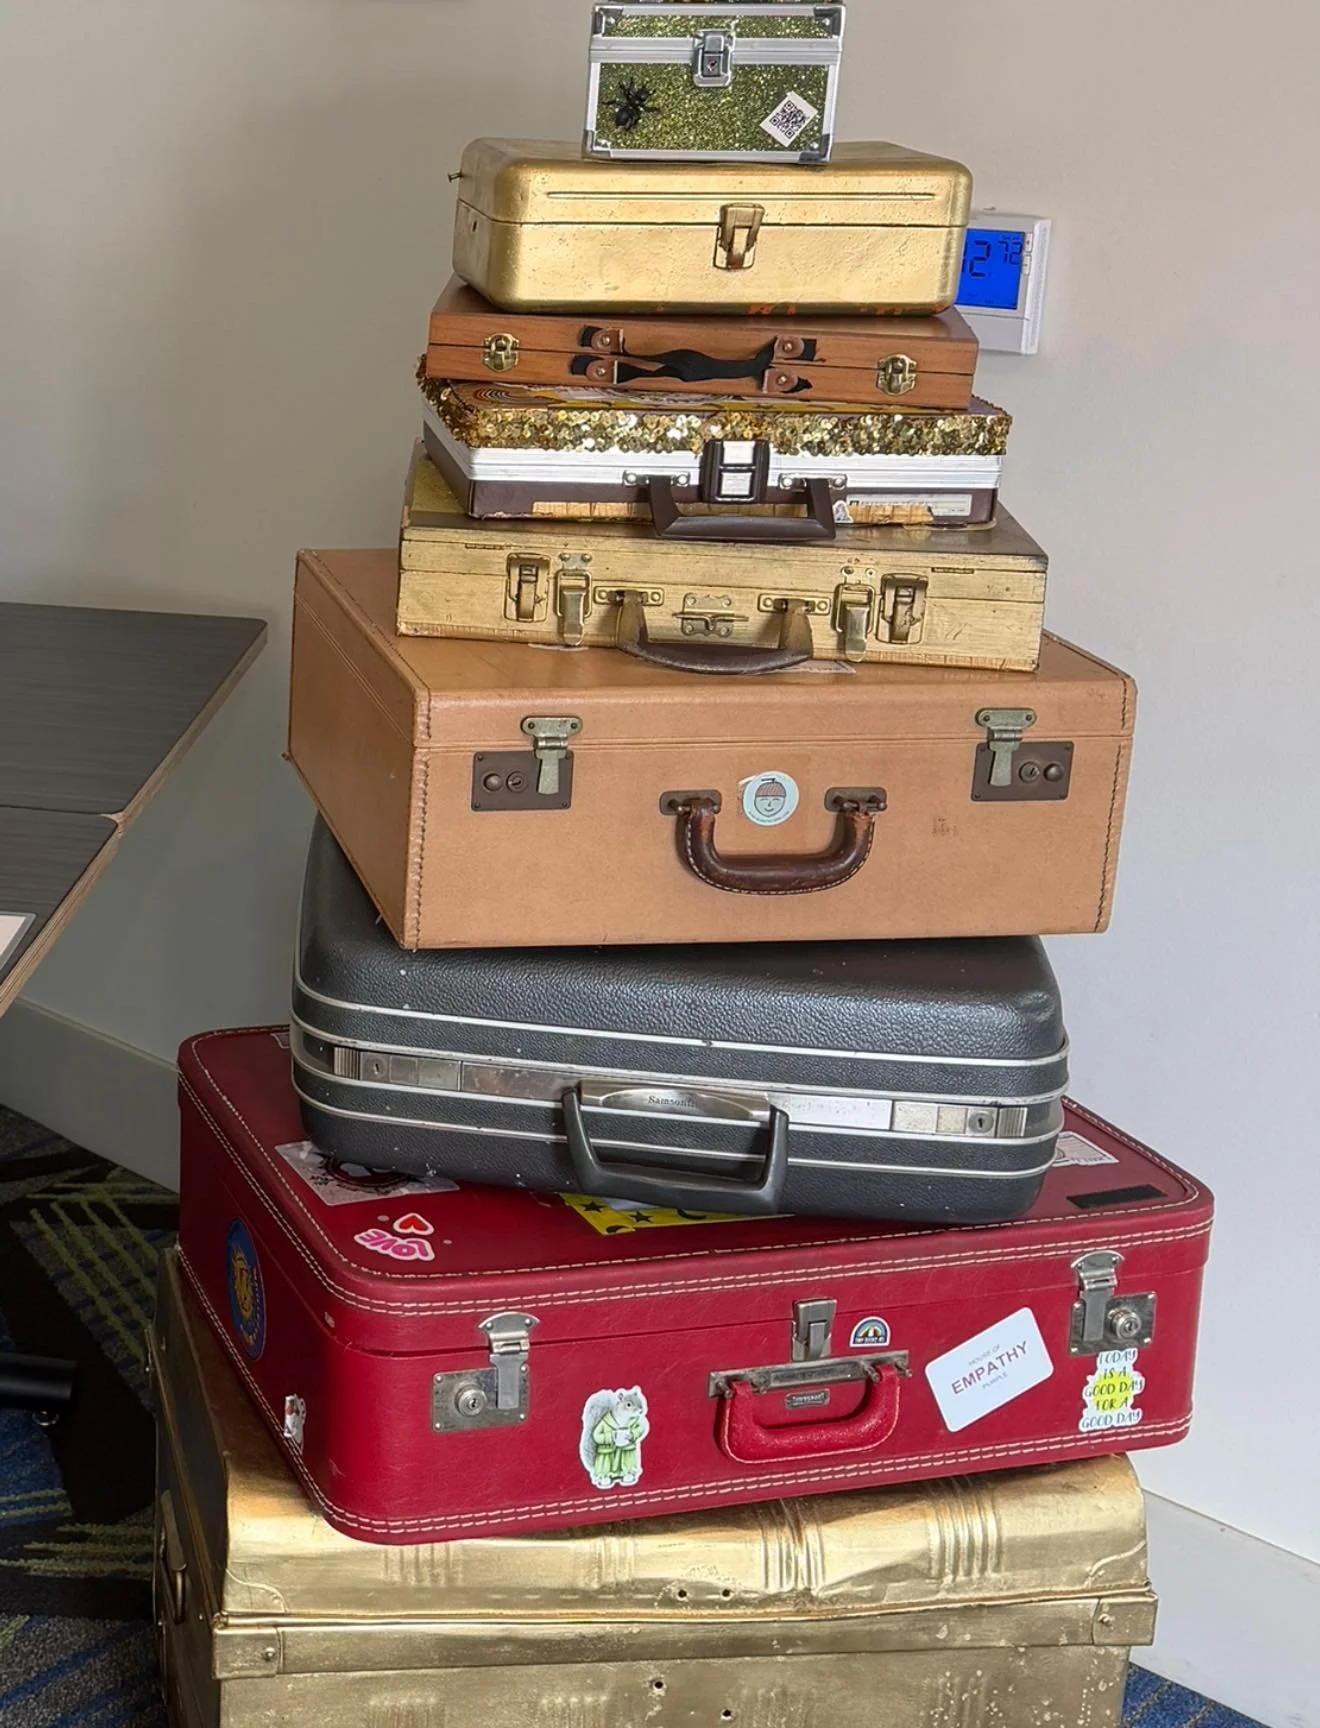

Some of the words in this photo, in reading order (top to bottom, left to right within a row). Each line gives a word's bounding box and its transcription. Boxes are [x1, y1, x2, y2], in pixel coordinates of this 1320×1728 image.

[998, 240, 1023, 265] 72
[356, 1230, 432, 1259] LOVE
[1099, 1350, 1136, 1364] TODAY
[951, 1340, 1027, 1395] EMPATHY
[1103, 1367, 1115, 1380] IS
[1118, 1366, 1127, 1377] A
[1084, 1383, 1116, 1397] GOOD
[1119, 1380, 1143, 1393] DAY
[1096, 1398, 1116, 1411] FOR
[1120, 1396, 1129, 1408] A
[1081, 1414, 1113, 1429] GOOD
[1116, 1411, 1140, 1423] DAY
